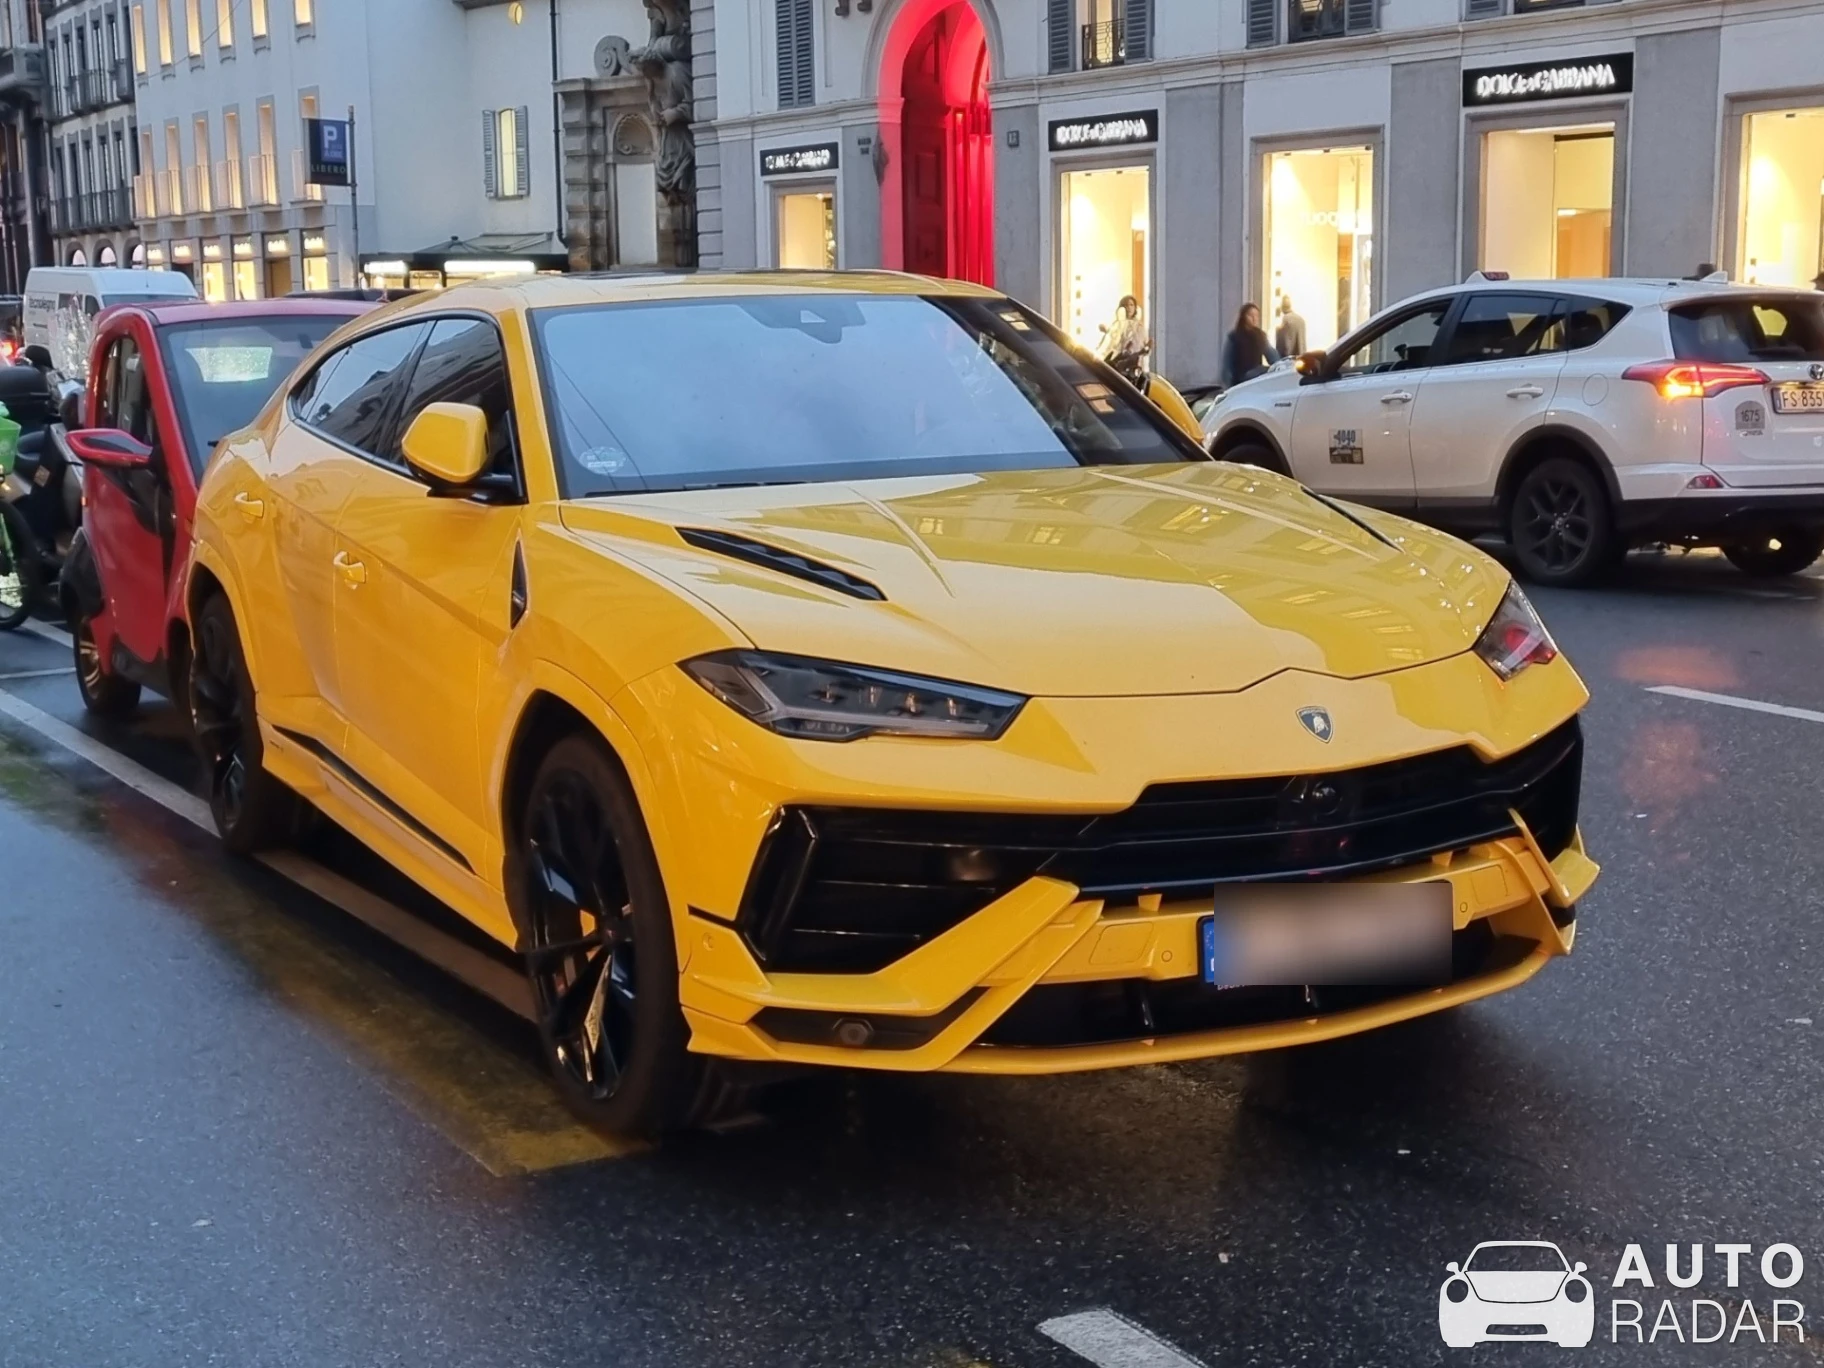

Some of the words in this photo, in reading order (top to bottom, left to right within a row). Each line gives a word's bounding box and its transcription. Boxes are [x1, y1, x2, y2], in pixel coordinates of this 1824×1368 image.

[323, 125, 337, 149] P
[311, 164, 346, 174] LIBERO
[1782, 391, 1798, 407] FS
[1741, 409, 1761, 422] 1675
